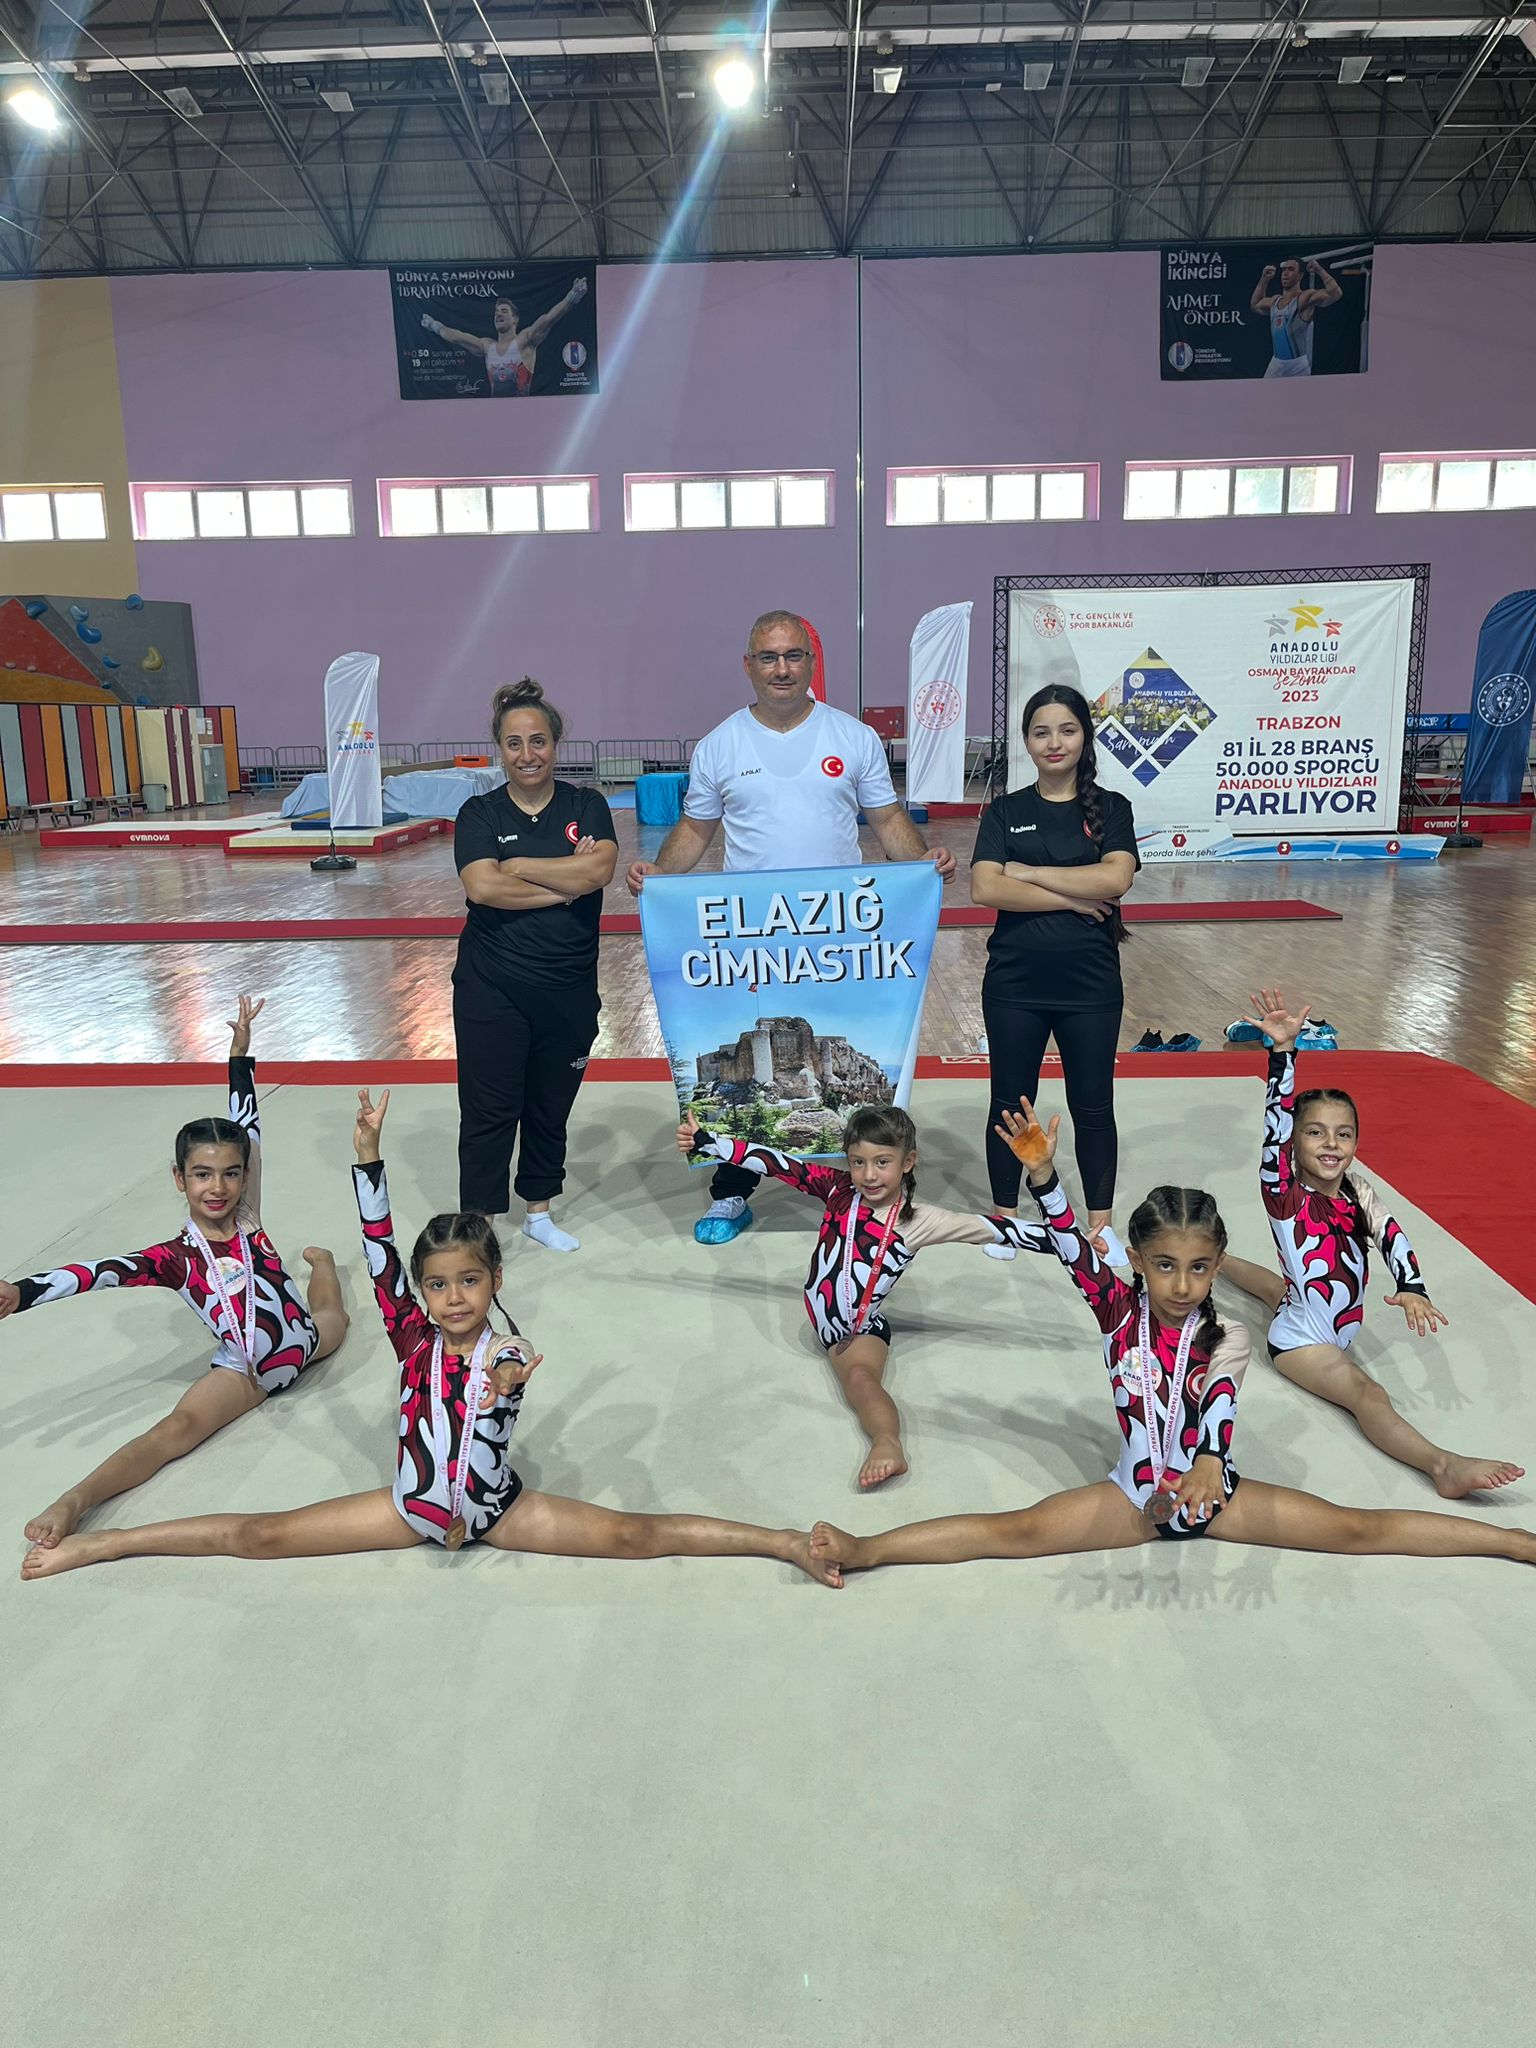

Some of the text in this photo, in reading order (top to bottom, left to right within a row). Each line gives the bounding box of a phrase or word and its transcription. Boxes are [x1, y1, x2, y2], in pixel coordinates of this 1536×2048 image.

[1168, 250, 1222, 265] DÜNYA
[396, 269, 514, 283] DÜNYA ŞAMPİYONU
[1168, 264, 1227, 280] İKİNCİSİ
[455, 283, 499, 298] ÇOLAK
[1166, 293, 1222, 311] AHMET
[1184, 310, 1246, 326] ÖNDER
[1086, 612, 1121, 621] GENÇLİK
[1091, 620, 1133, 629] BAKANLIĞI
[1270, 641, 1339, 653] ANADOLU
[1270, 653, 1318, 664] YILDIZLAR
[1248, 666, 1356, 677] OSMAN BAYRAKDAR
[1281, 690, 1319, 702] 2023
[1256, 716, 1341, 730] TRABZON
[1223, 737, 1374, 758] 81 İL 28 BRANŞ
[1216, 758, 1379, 777] 50.000 SPORCU
[1217, 776, 1377, 790] ANADOLU YILDIZLARI
[1215, 790, 1377, 816] PARLIYOR
[1176, 836, 1182, 844] 1
[1281, 843, 1288, 851] 3
[1142, 848, 1217, 858] sporda lider şehir
[696, 876, 884, 939] ELAZIĞ
[681, 933, 916, 987] CİMNASTİK
[1123, 1370, 1157, 1385] ANADU
